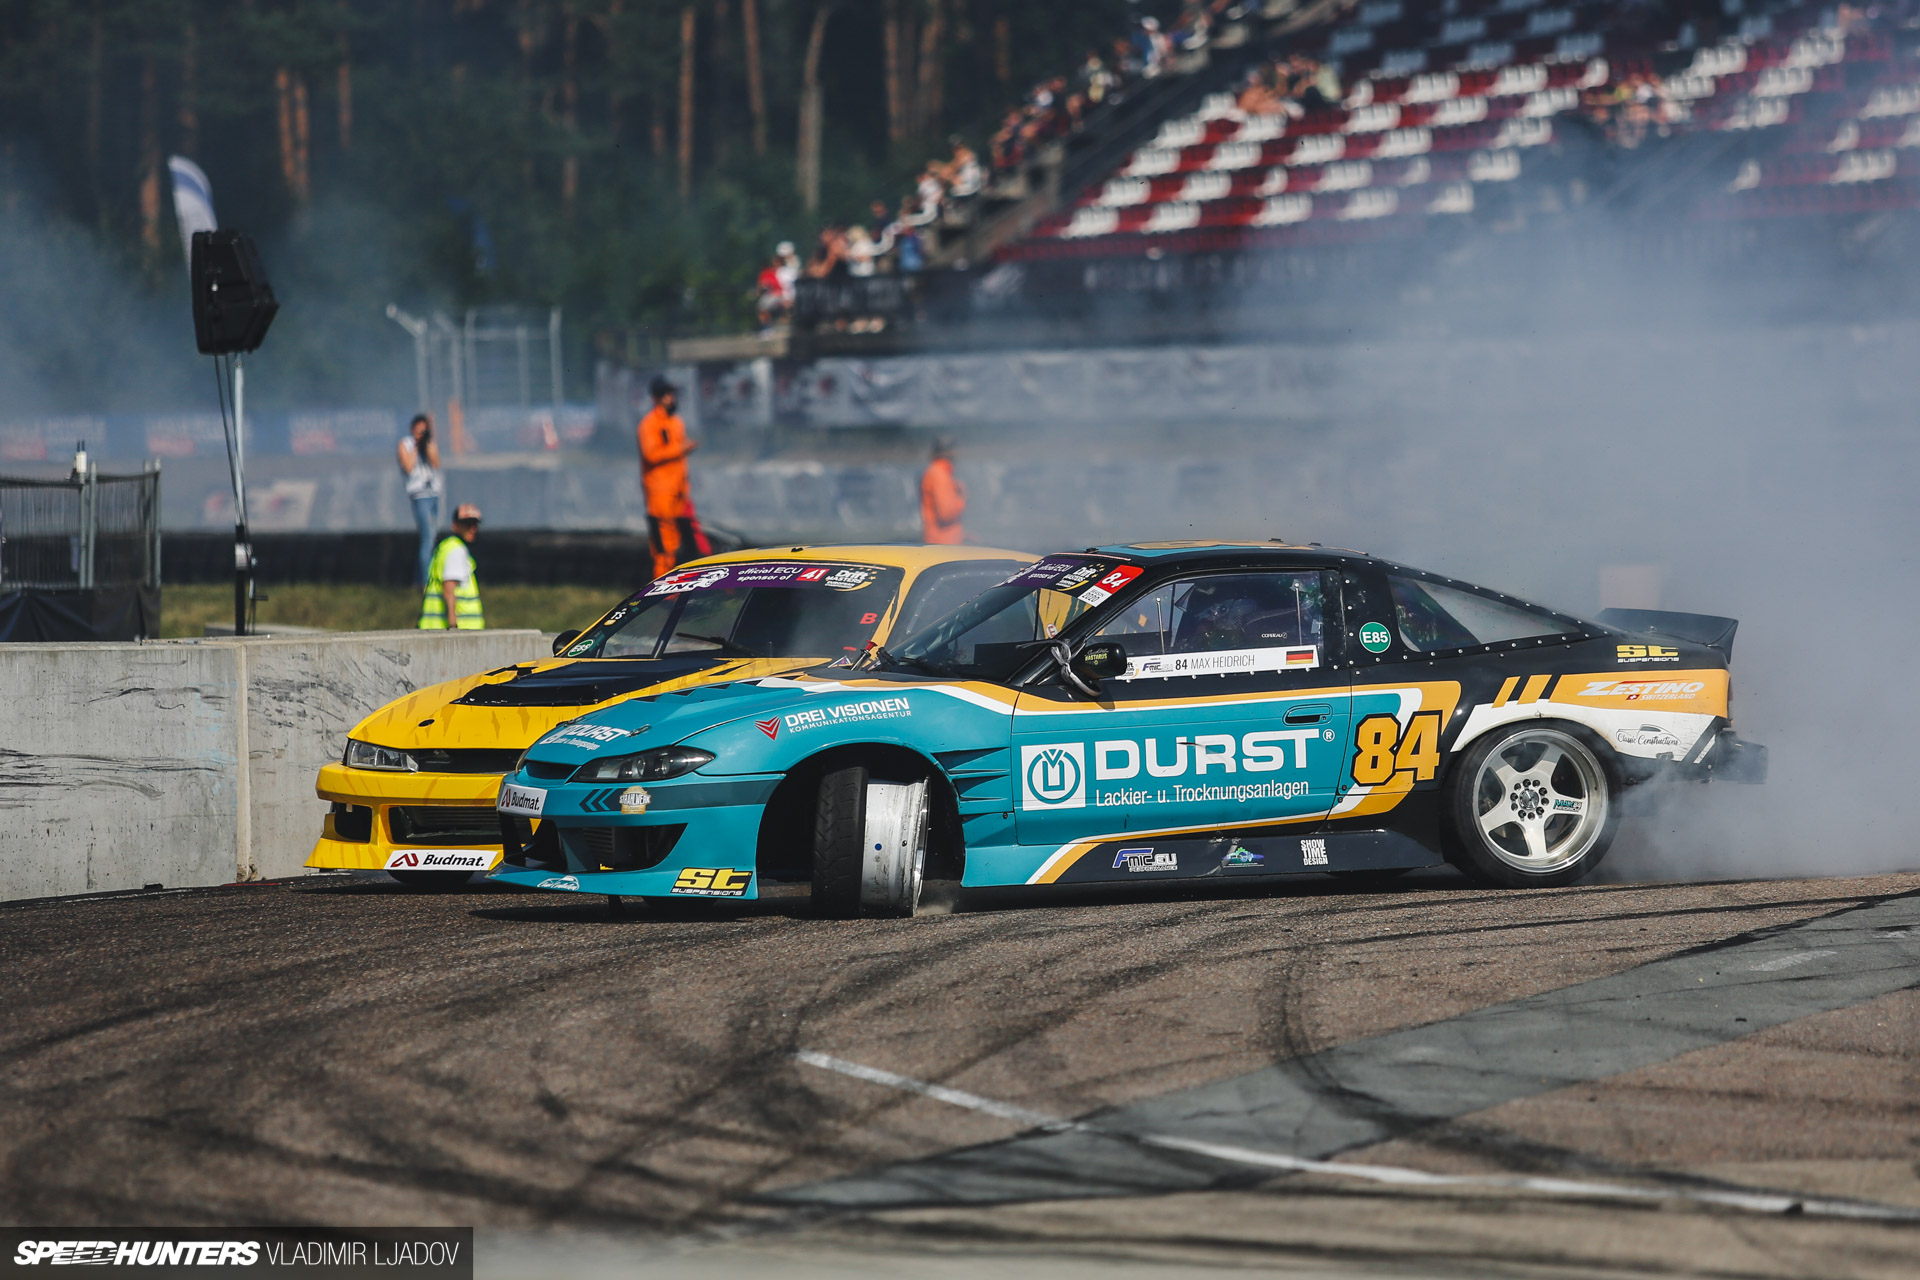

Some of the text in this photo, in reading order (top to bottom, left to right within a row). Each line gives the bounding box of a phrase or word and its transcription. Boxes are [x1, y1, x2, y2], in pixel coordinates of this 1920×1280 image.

[738, 566, 803, 576] official ECU
[800, 569, 826, 580] 41
[835, 569, 869, 580] Drift
[736, 573, 793, 583] sponsor of
[825, 575, 864, 584] MASTERS
[1101, 572, 1130, 588] 84
[859, 612, 878, 624] B
[1362, 631, 1389, 644] E85
[1175, 654, 1255, 671] 84 MAX HEIDRICH
[1617, 656, 1680, 664] SUSPENSIONS
[1577, 680, 1704, 697] ZESTINO
[1639, 692, 1696, 701] SWITZERLAND
[784, 697, 910, 728] DREI VISIONEN
[788, 710, 912, 734] KOMMUNIKATIONSAGENTUR
[566, 724, 631, 743] DURST
[1617, 732, 1679, 748] Classic Constructions
[1095, 728, 1321, 781] DURST
[1350, 710, 1443, 786] 84
[1095, 780, 1310, 808] Lackier- u. Trocknungsanlagen
[510, 791, 541, 811] Budmat.
[1300, 839, 1325, 849] SHOW
[1301, 847, 1327, 859] TIME
[422, 854, 485, 868] Budmat.
[1303, 857, 1329, 866] DESIGN
[671, 887, 744, 896] SUSPENSIONS
